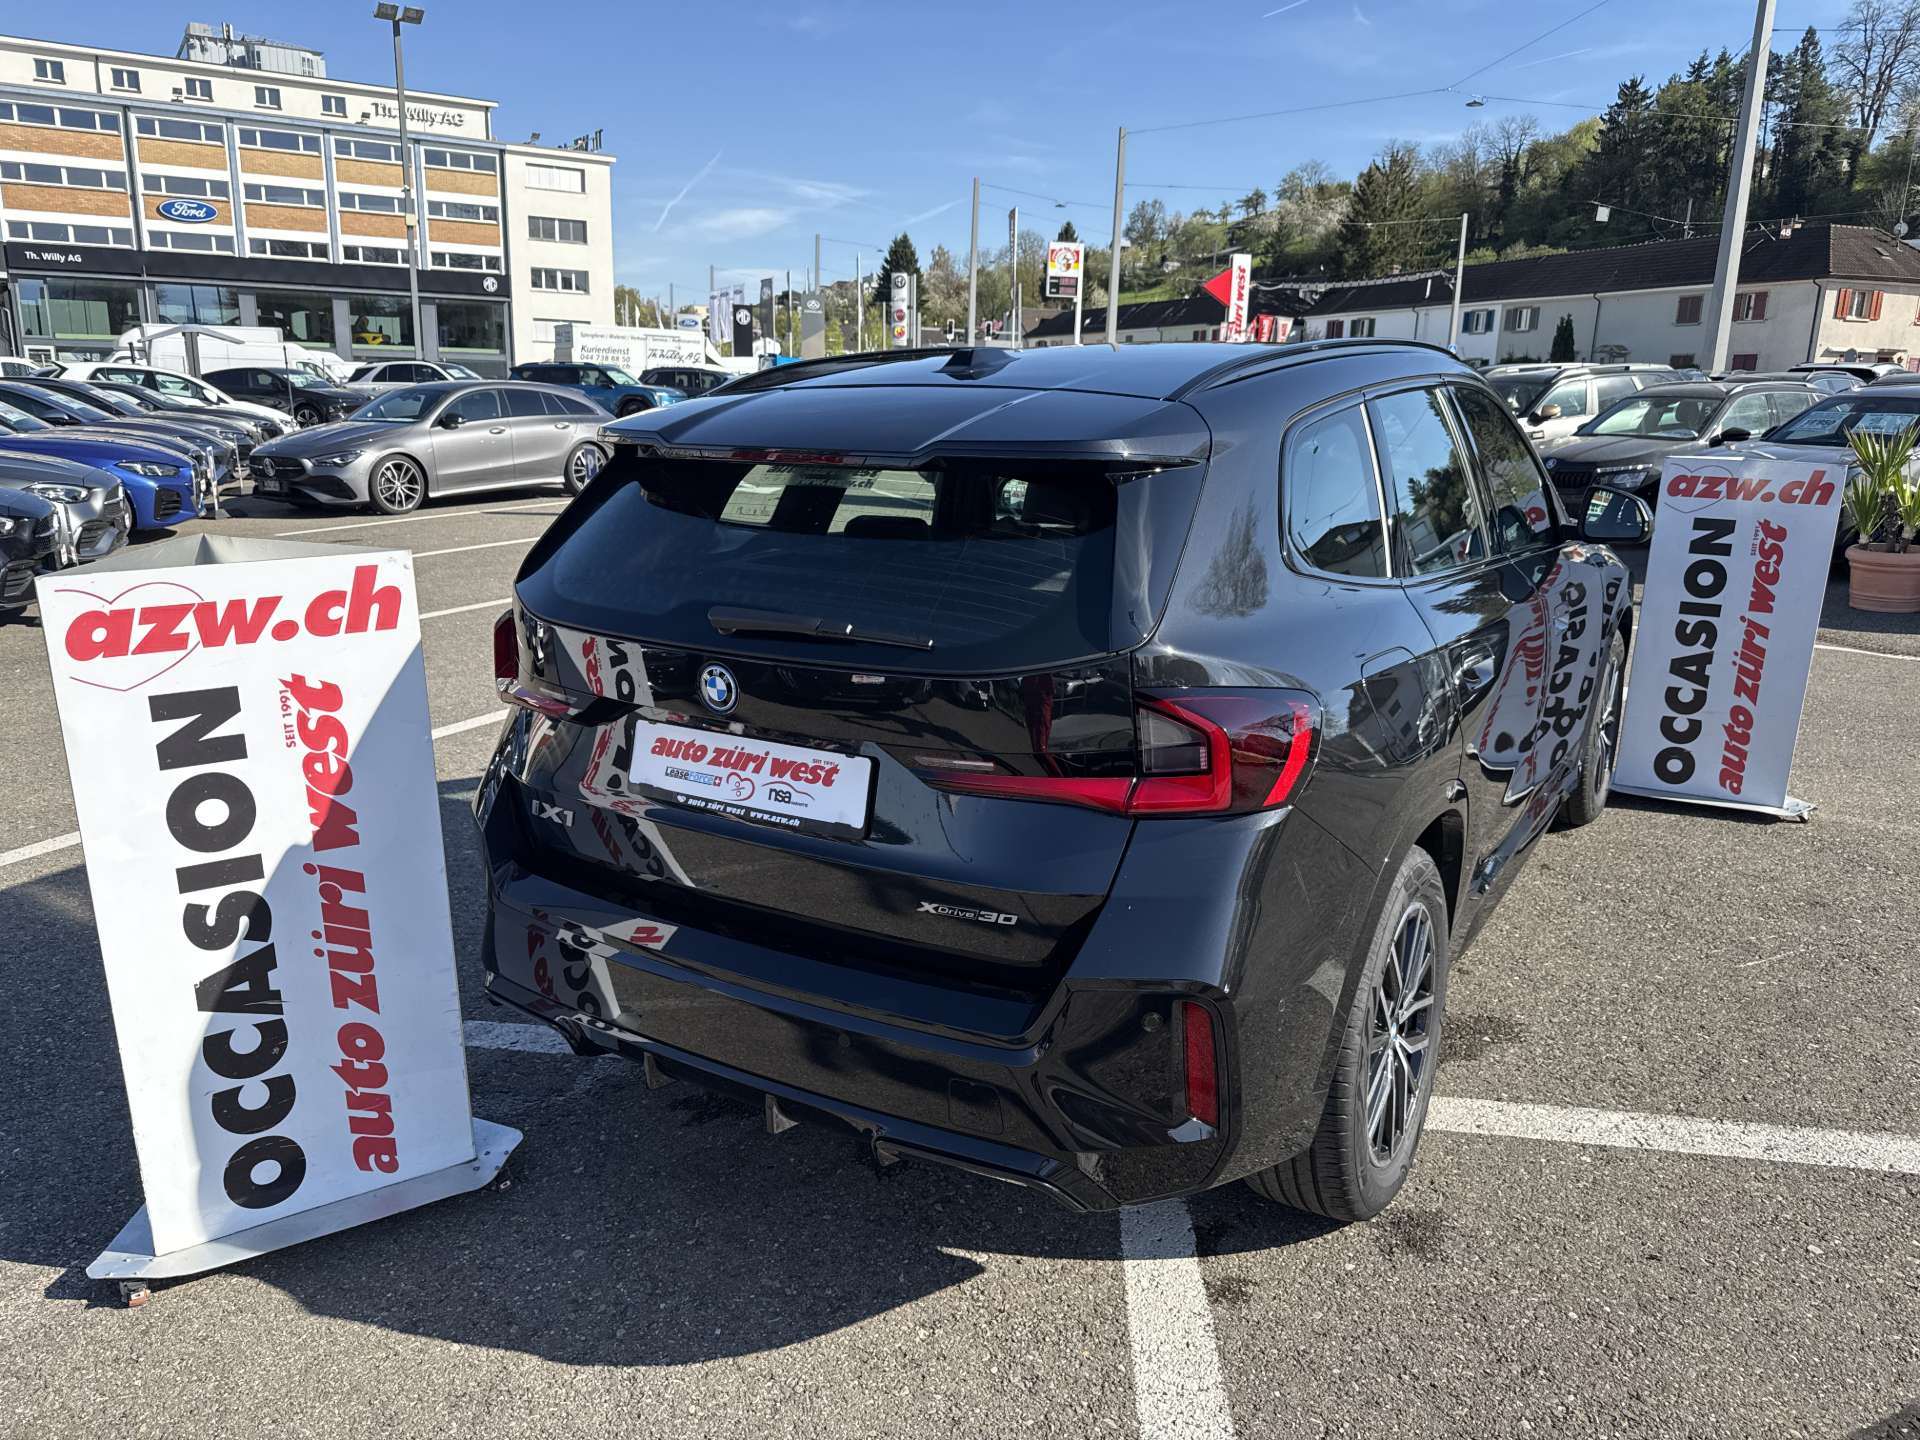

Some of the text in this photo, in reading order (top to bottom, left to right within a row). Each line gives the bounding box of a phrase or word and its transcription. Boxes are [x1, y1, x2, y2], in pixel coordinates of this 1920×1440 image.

[169, 200, 208, 219] Ford
[24, 250, 82, 263] Th. Willy AG
[580, 344, 630, 356] Kurierdienst
[580, 353, 595, 361] 044
[1666, 469, 1836, 506] azw.ch
[64, 564, 402, 662] azw.ch
[1653, 517, 1737, 785] OCCASION
[1718, 518, 1788, 796] auto züri west
[279, 689, 297, 748] SEIT 1991
[650, 735, 841, 788] auto züri west
[664, 766, 716, 786] LeaseForce
[687, 797, 801, 827] auto züri west www.azw.ch
[768, 788, 792, 804] nsa
[279, 673, 400, 1174] auto züri west
[148, 685, 307, 1210] OCCASION
